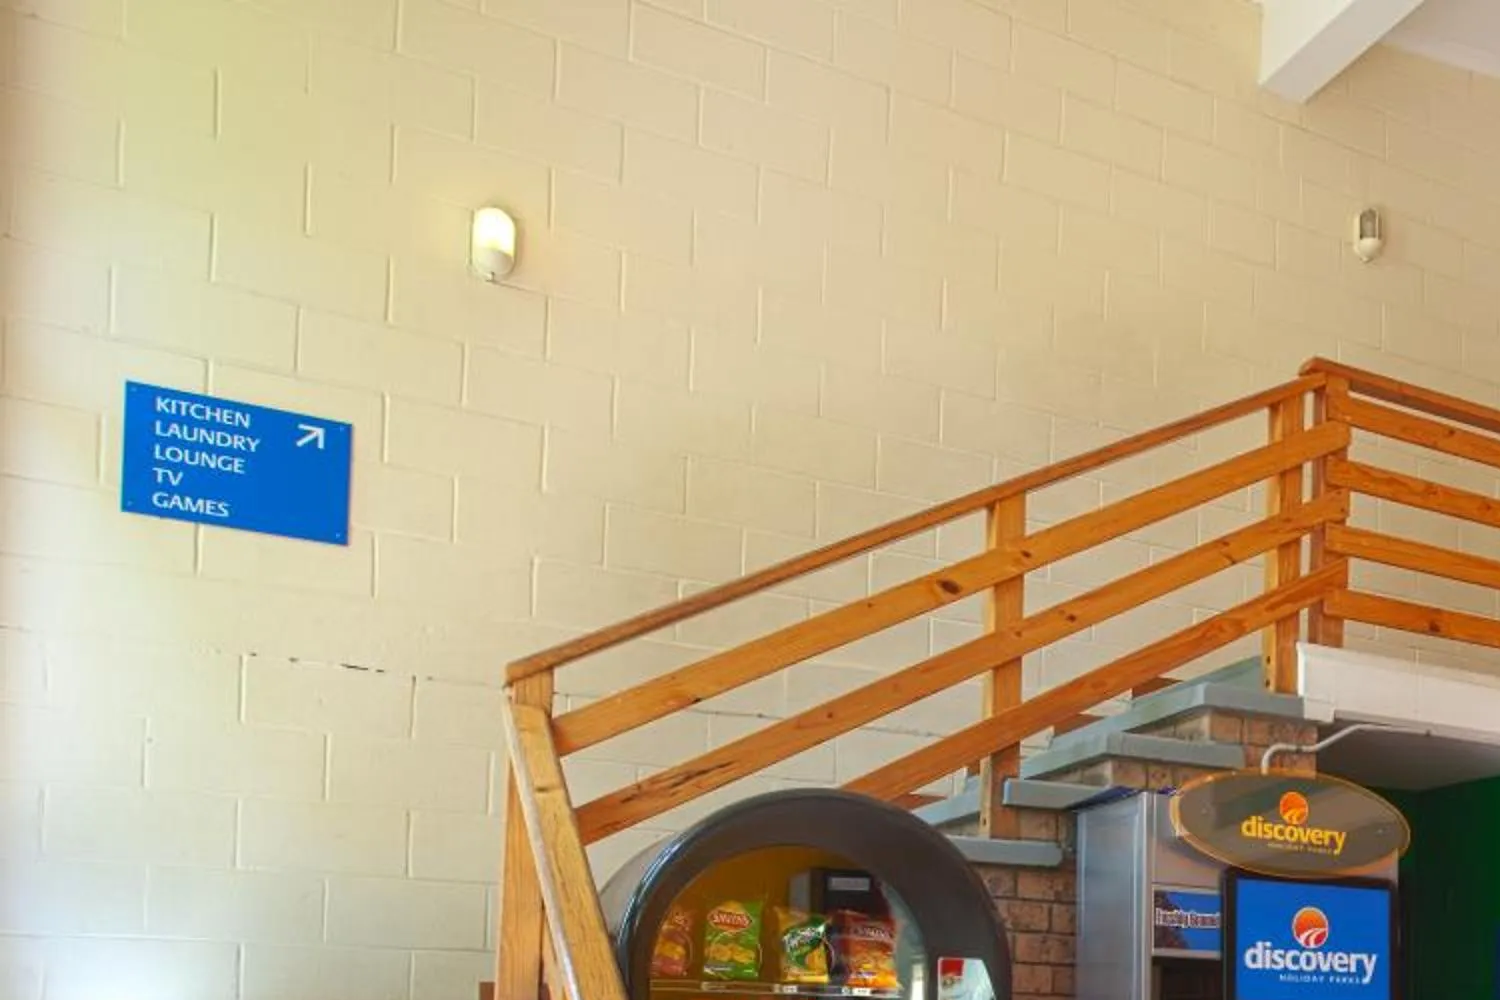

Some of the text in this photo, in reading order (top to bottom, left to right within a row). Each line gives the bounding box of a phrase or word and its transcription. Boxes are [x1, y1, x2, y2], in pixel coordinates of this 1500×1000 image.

[156, 396, 251, 428] KITCHEN
[155, 420, 261, 453] LAUNDRY
[154, 444, 246, 475] LOUNGE
[153, 467, 184, 487] TV
[152, 491, 231, 518] GAMES
[1241, 815, 1346, 855] discovery
[1244, 941, 1377, 985] discovery
